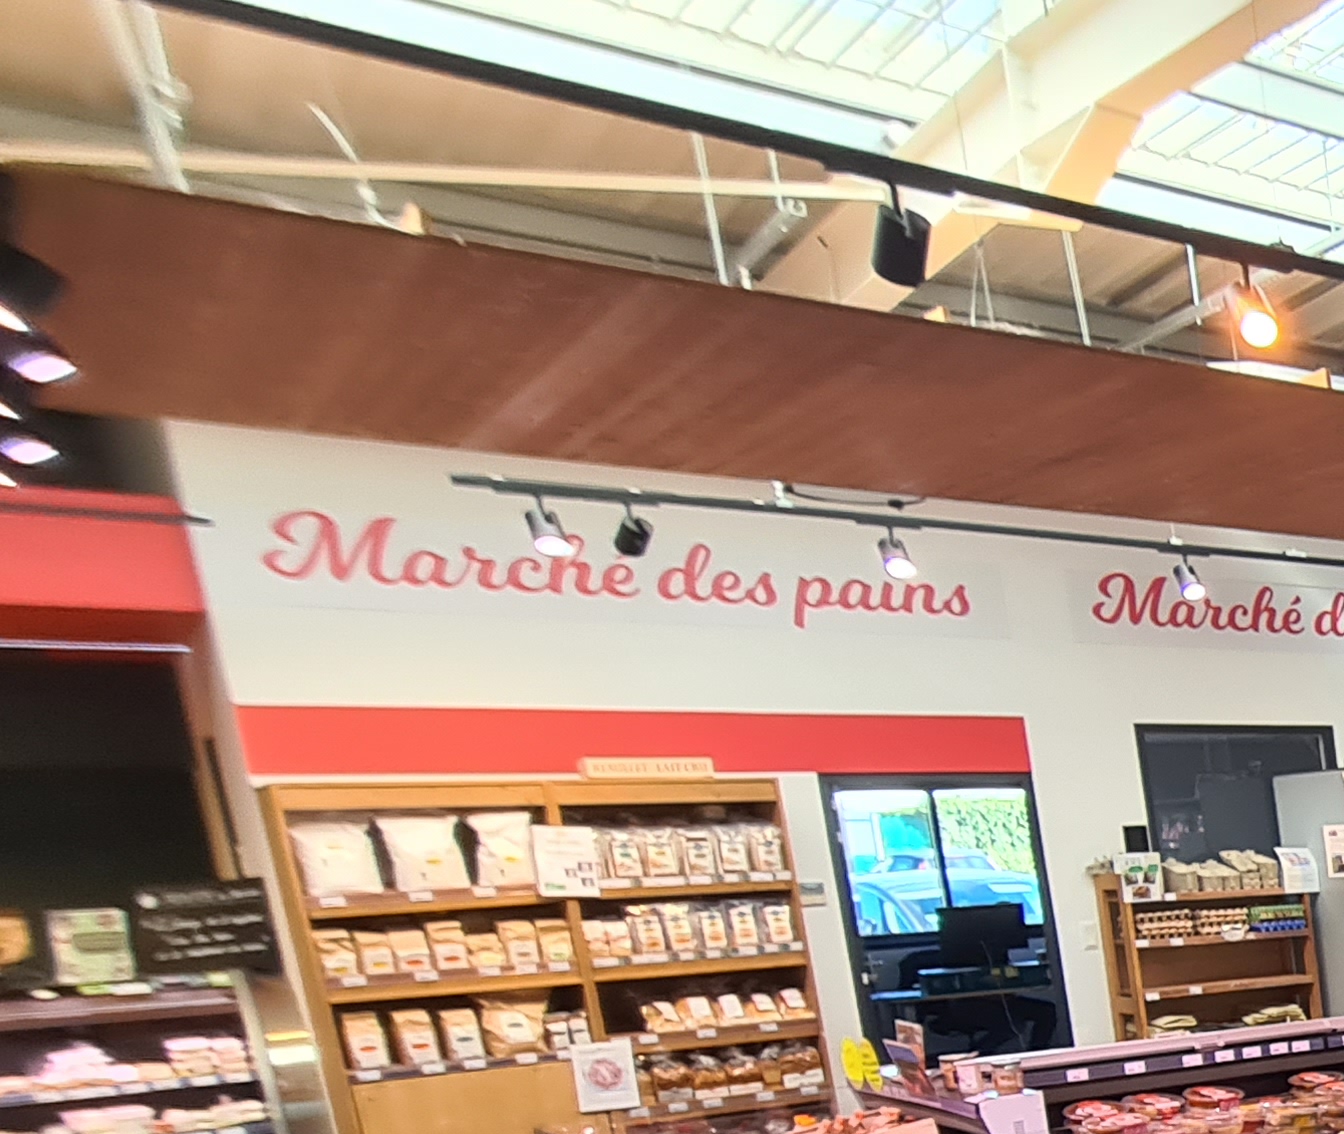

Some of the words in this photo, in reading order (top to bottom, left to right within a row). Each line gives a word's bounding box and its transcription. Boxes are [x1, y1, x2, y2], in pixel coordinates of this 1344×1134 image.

[262, 511, 638, 597] Marché
[657, 543, 779, 606] des
[794, 572, 971, 629] pains
[1092, 572, 1305, 634] Marché
